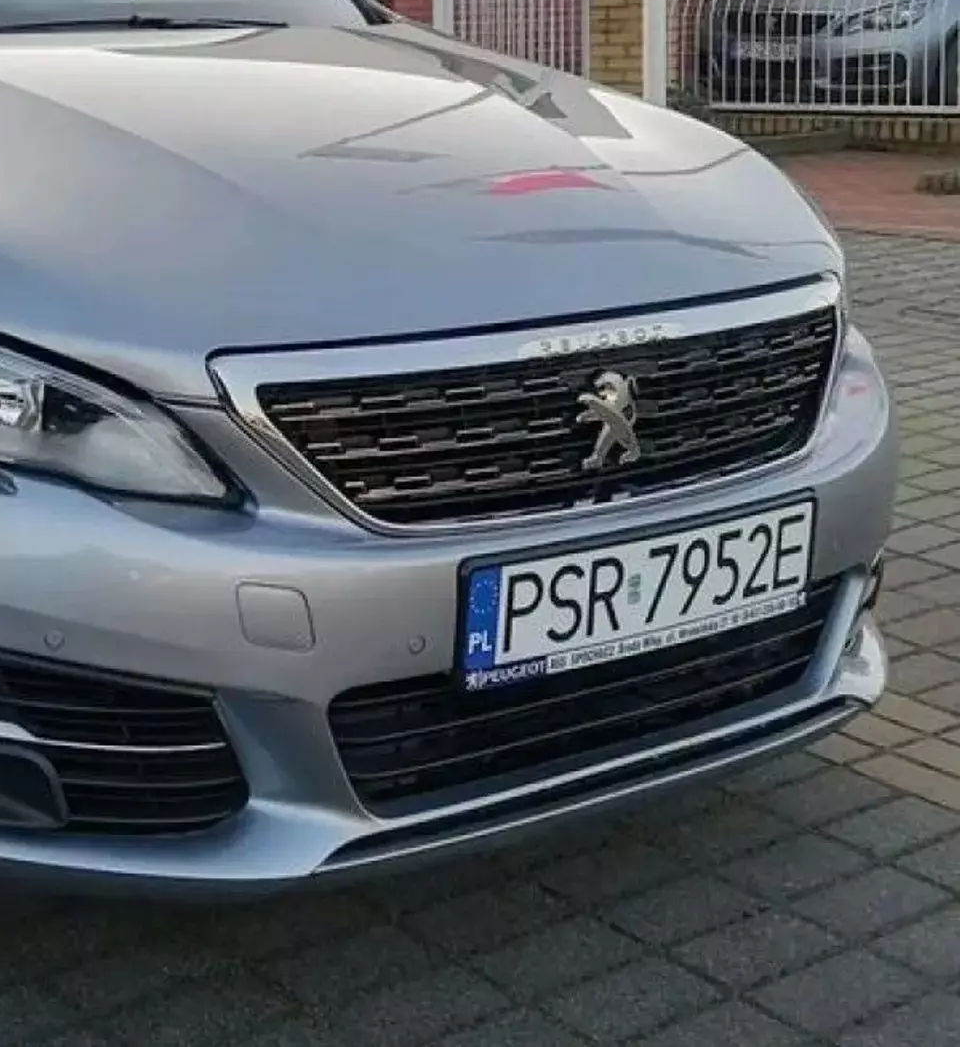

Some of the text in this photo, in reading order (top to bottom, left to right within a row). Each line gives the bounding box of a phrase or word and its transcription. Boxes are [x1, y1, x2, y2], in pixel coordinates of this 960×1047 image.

[503, 514, 806, 653] PSR 7952E
[468, 629, 492, 655] PL
